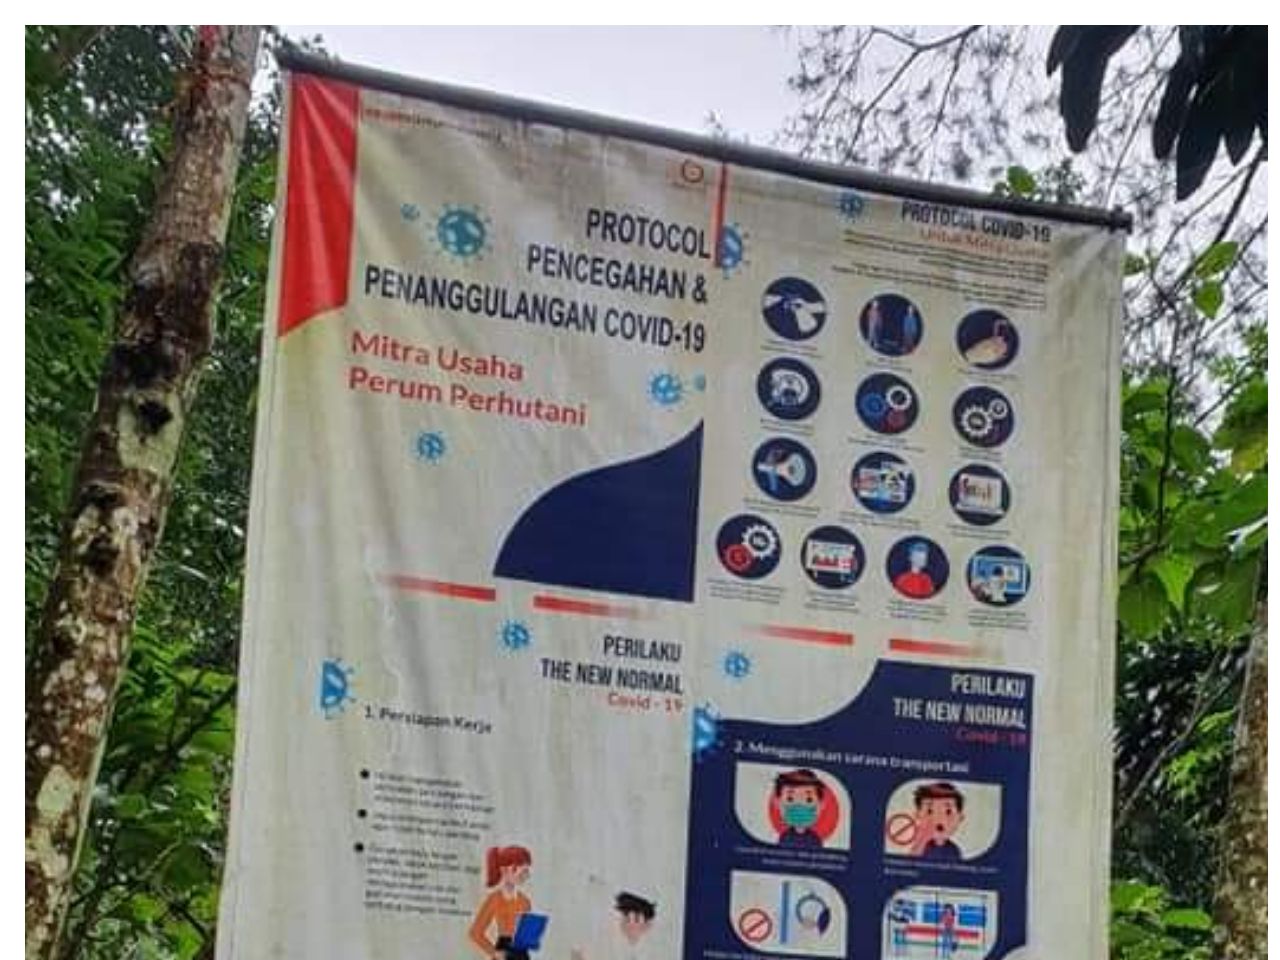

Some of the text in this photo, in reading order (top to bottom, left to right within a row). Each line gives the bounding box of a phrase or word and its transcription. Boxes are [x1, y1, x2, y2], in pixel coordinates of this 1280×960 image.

[586, 208, 711, 260] PROTOCOL
[527, 244, 709, 303] PENCEGAHAN &
[365, 265, 705, 353] PENANGGULANGAN COVID-19
[351, 330, 524, 382] Mitra Usaha
[349, 367, 587, 427] Perum Perhutani
[603, 634, 683, 662] PERILAKU
[541, 658, 683, 695] THE NEW NORMAL
[950, 673, 1026, 699] PERILAKU
[893, 698, 1026, 730] THE NEW NORMAL
